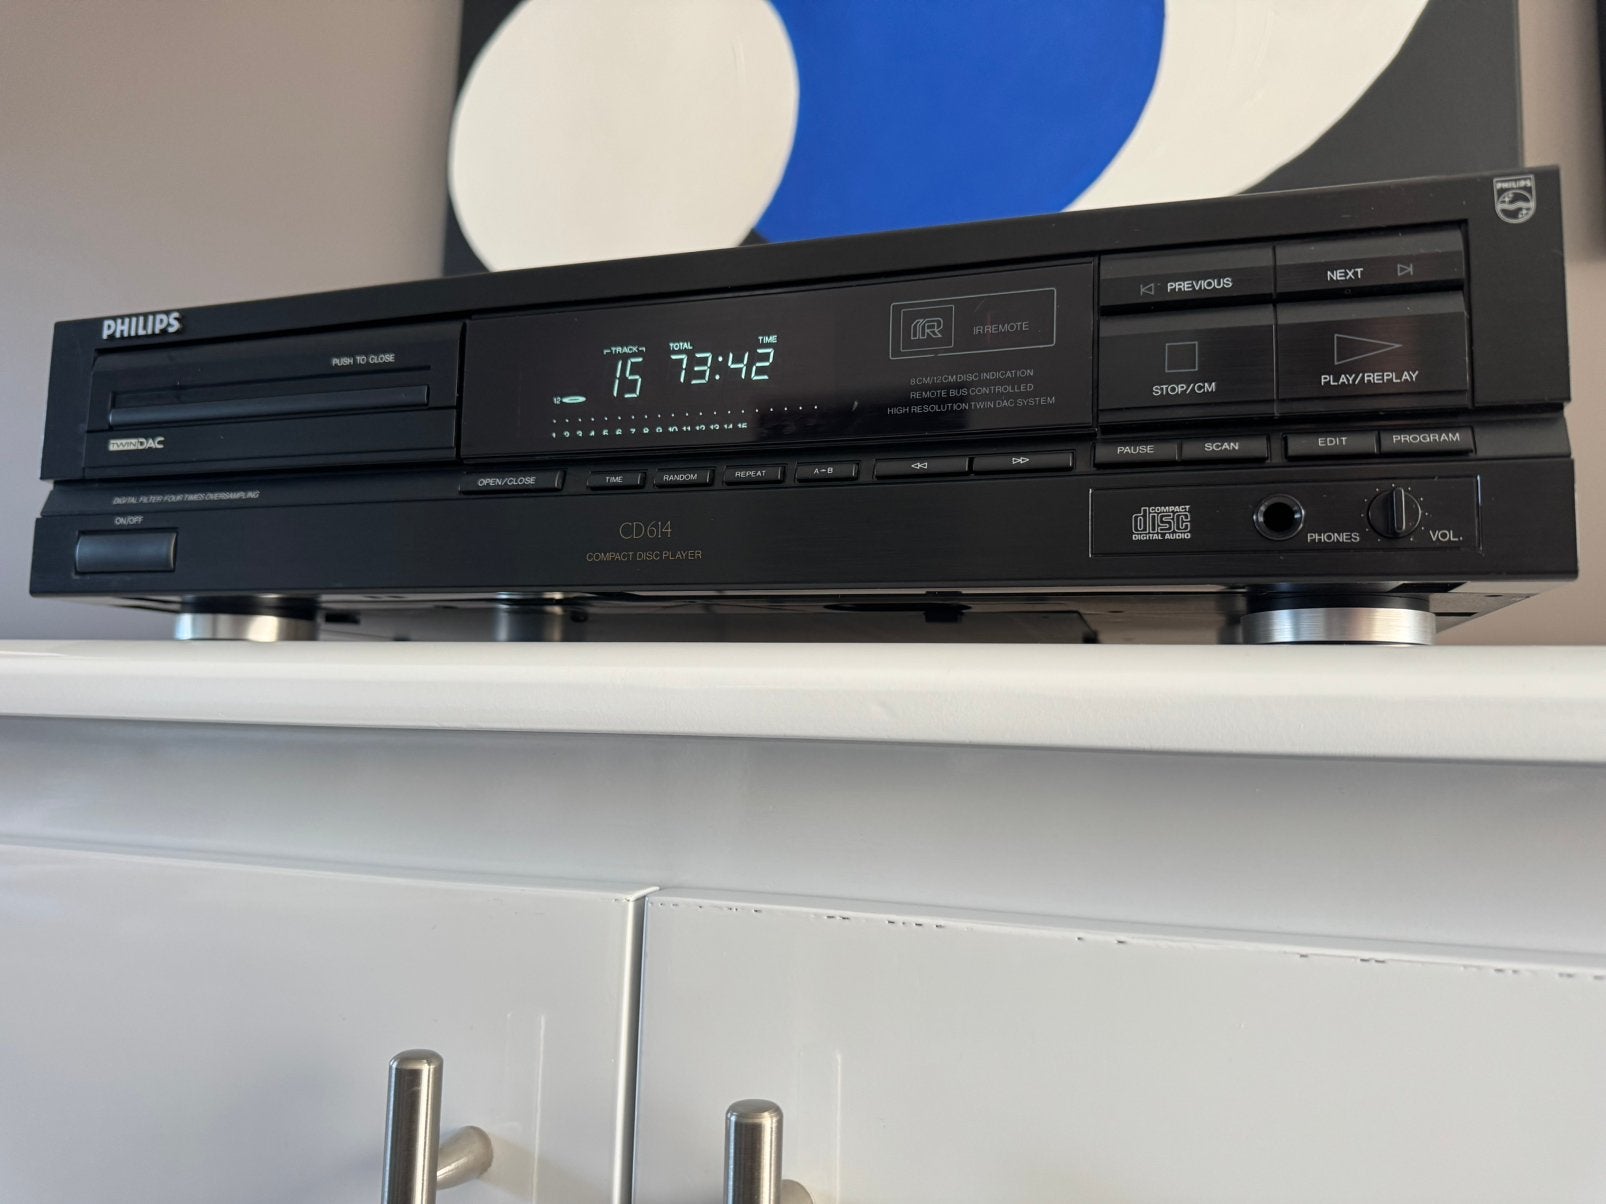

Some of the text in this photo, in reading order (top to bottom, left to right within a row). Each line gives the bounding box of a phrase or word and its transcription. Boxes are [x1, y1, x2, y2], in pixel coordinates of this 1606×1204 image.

[1496, 178, 1531, 190] PHILIPS
[1327, 268, 1364, 282] NEXT
[1167, 277, 1232, 292] PREVIOUS
[102, 312, 181, 340] PHILIPS
[973, 321, 1030, 335] IR REMOTE
[758, 335, 778, 344] TIME
[611, 346, 638, 354] TRACK
[669, 342, 693, 350] TOTAL
[332, 353, 396, 367] PUSH TO CLOSE
[670, 348, 775, 384] 73:42
[612, 356, 644, 398] 15
[958, 372, 979, 382] DISC
[980, 369, 1034, 380] INDICATION
[1320, 370, 1419, 386] PLAY/REPLAY
[910, 384, 1034, 399] REMOTE BUS CONTROLLED
[1152, 382, 1216, 396] STOP/CM
[887, 396, 1056, 415] HIGH RESOLUTION TWIN DAC SYSTEM
[1318, 436, 1348, 447] EDIT
[1392, 432, 1460, 444] PROGRAM
[1117, 444, 1154, 455] PAUSE
[1204, 441, 1240, 452] SCAN
[604, 475, 624, 484] TIME
[663, 472, 698, 482] RANDOM
[734, 470, 766, 478] REPEAT
[478, 476, 536, 486] OPEN/CLOSE
[112, 490, 260, 504] DIGITAL FILTER FOUR TIMES OVERSAMPLING
[1149, 505, 1190, 513] COMPACT
[114, 515, 144, 526] ON/OFF
[1306, 532, 1360, 543] PHONES
[1429, 530, 1464, 542] VOL.
[586, 550, 702, 562] COMPACT DISC PLAYER
